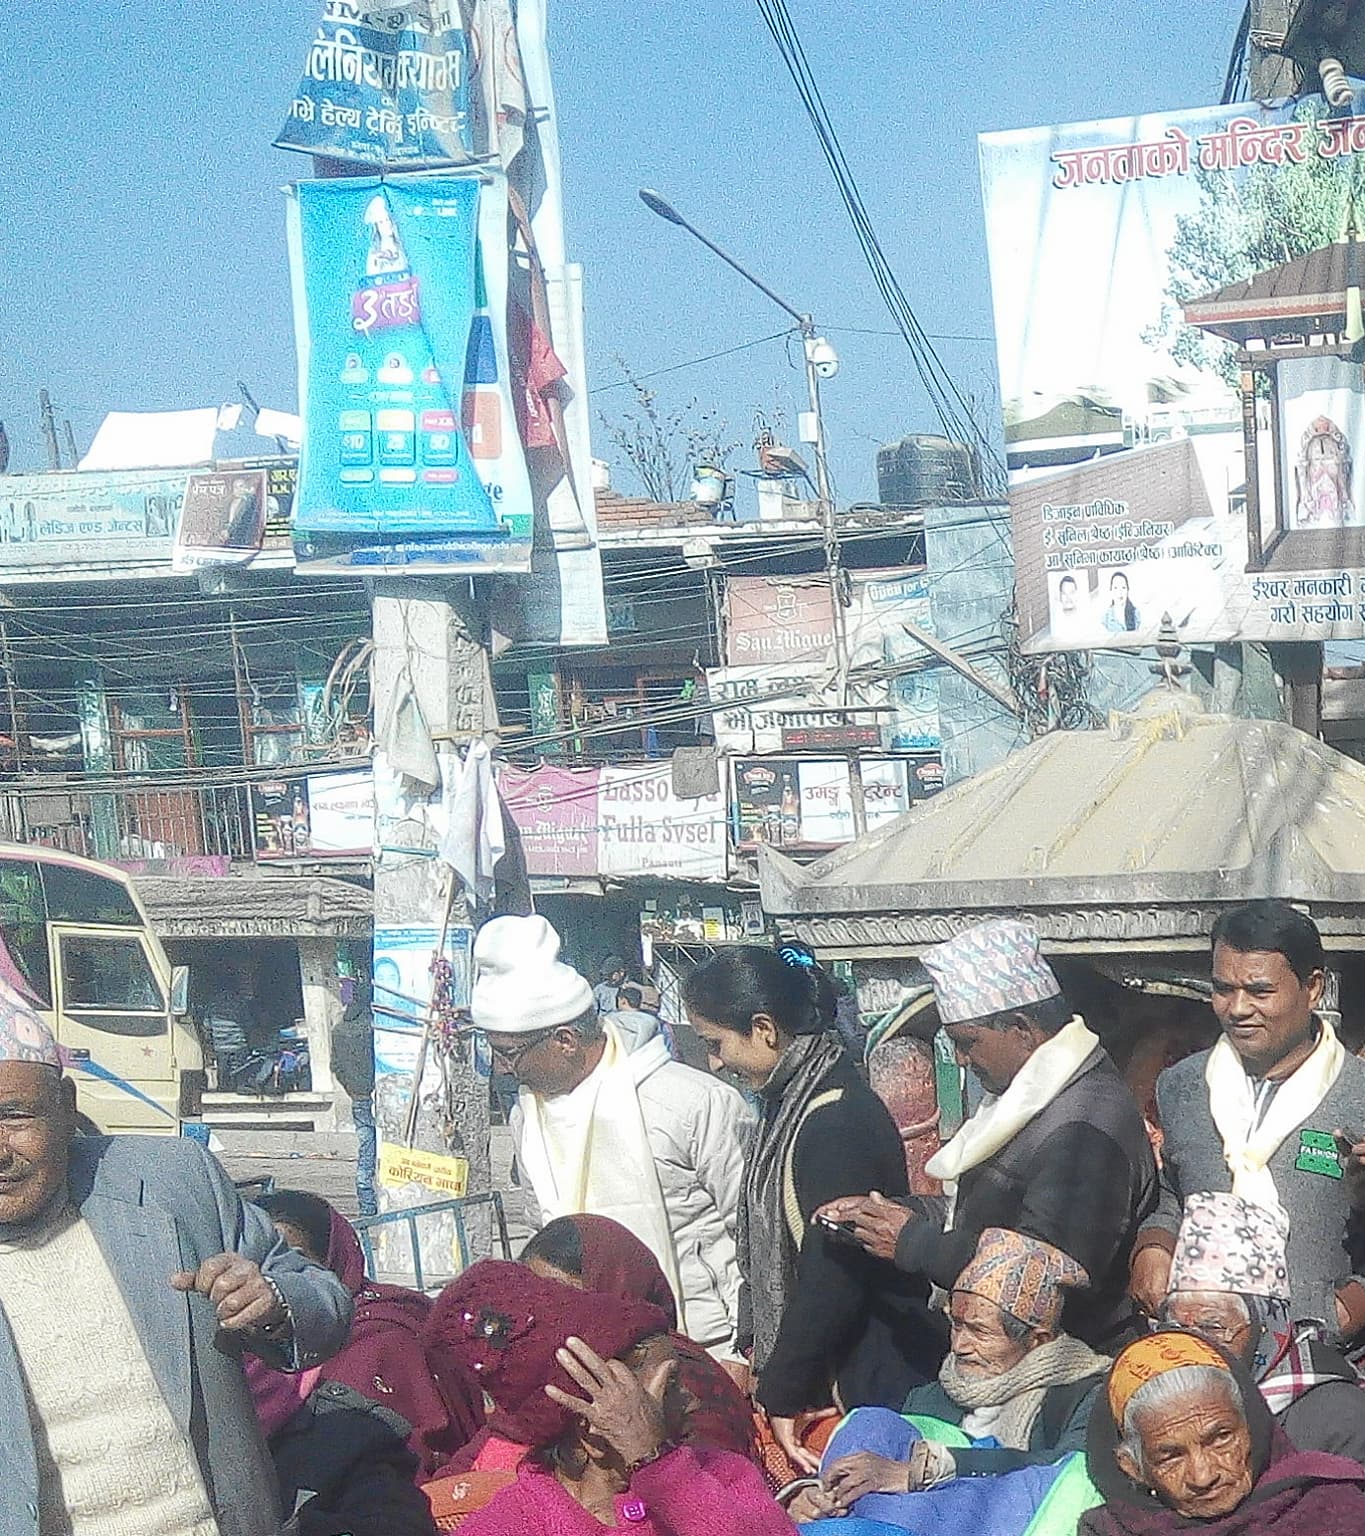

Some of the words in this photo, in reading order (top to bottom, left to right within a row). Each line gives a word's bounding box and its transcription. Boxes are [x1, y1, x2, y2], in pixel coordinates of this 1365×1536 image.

[1052, 128, 1190, 189] जनताको
[1198, 117, 1310, 171] मन्दिर
[1301, 600, 1354, 622] सहयोग
[736, 631, 772, 652] San
[775, 629, 834, 652] Migue
